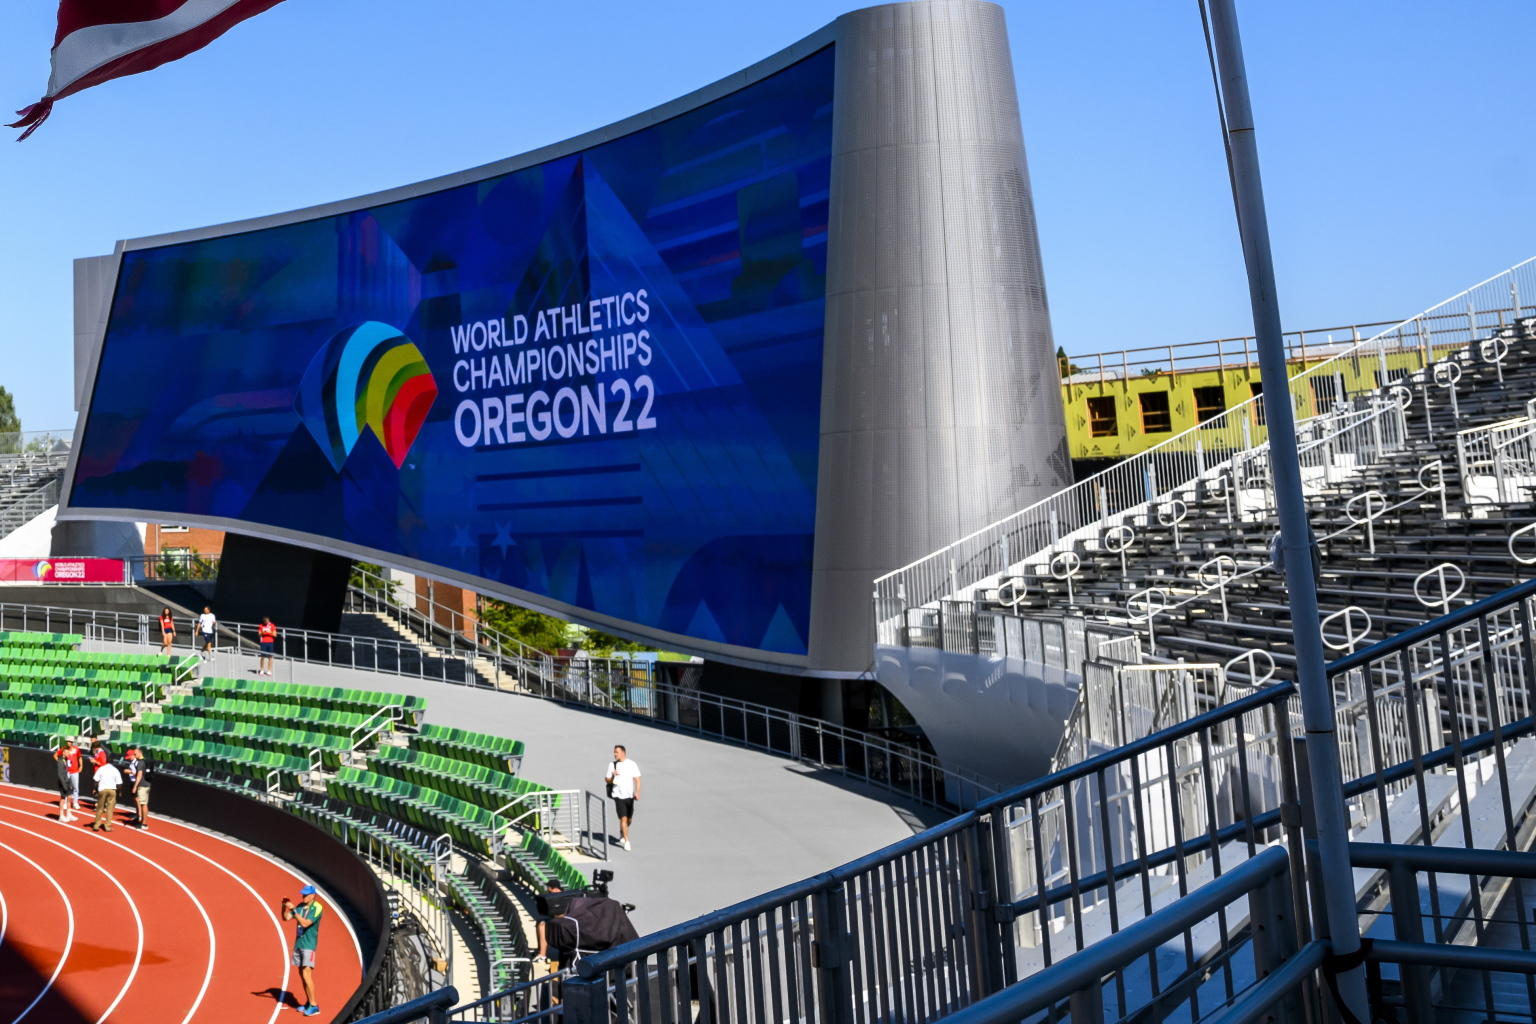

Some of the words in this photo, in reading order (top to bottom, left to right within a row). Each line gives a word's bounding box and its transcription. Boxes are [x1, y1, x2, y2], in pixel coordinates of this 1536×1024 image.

[451, 314, 528, 354] WORLD
[534, 289, 650, 342] ATHLETICS
[453, 329, 652, 392] CHAMPIONSHIPS
